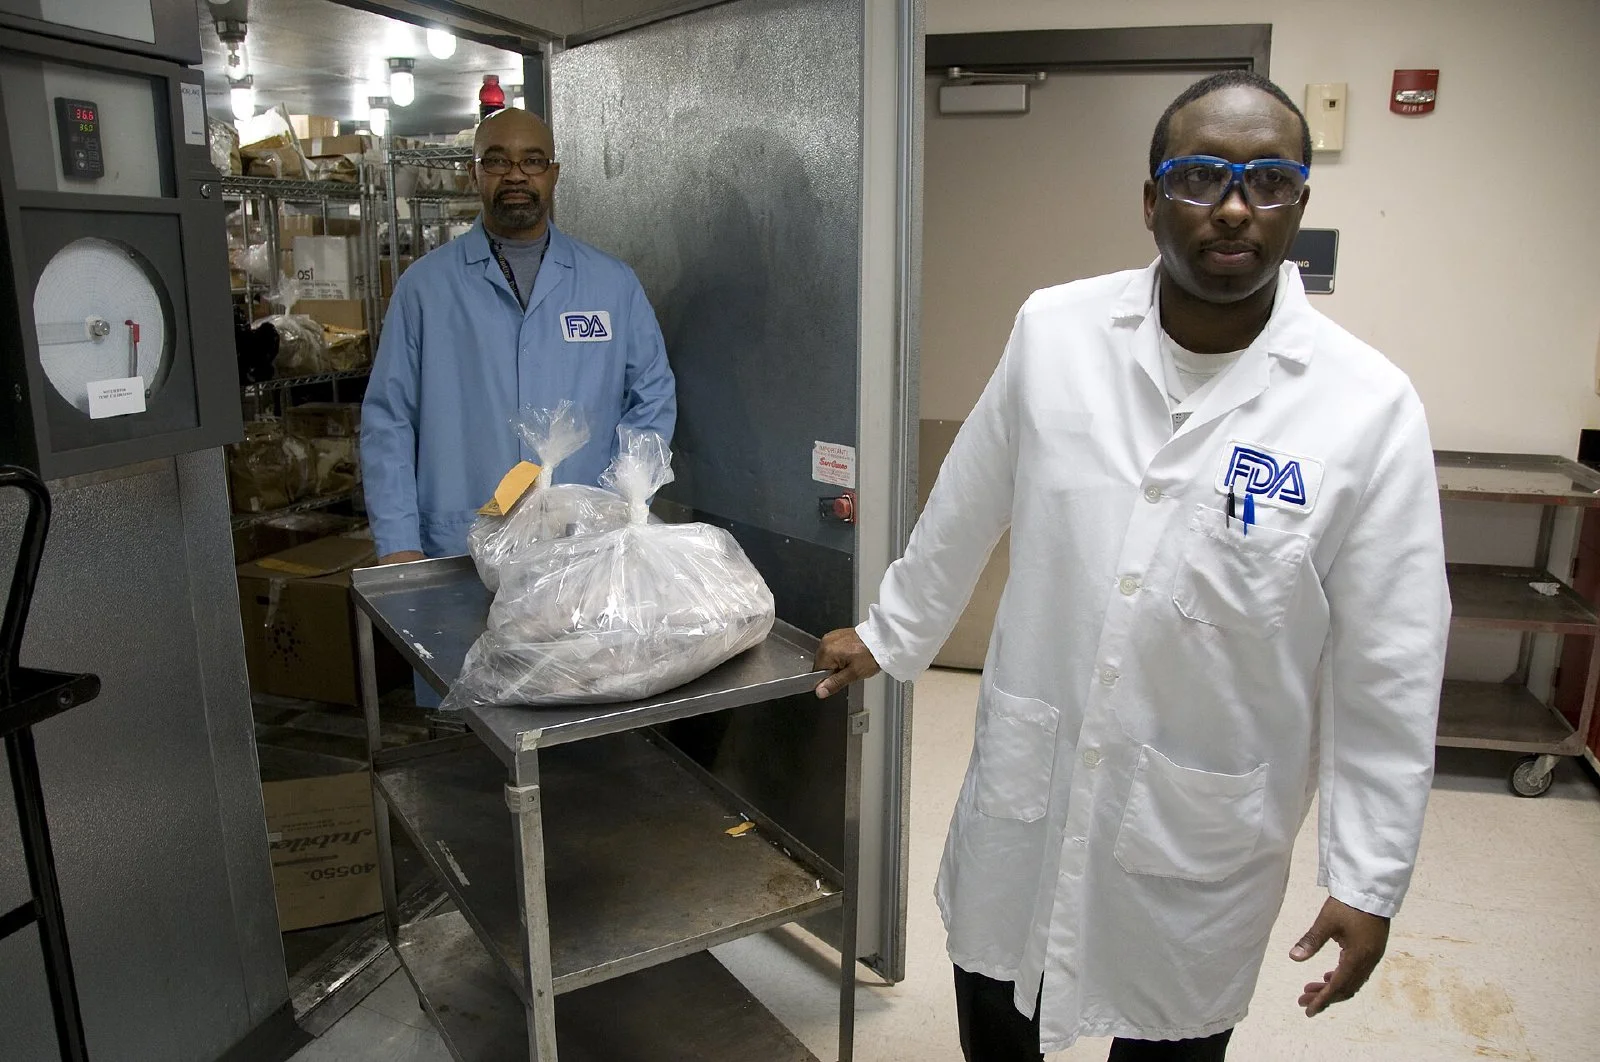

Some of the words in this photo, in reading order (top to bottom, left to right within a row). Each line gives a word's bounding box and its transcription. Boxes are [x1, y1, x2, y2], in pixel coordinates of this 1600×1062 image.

[1402, 104, 1424, 112] FIRE
[564, 314, 608, 338] FDA
[1223, 446, 1307, 506] FDA
